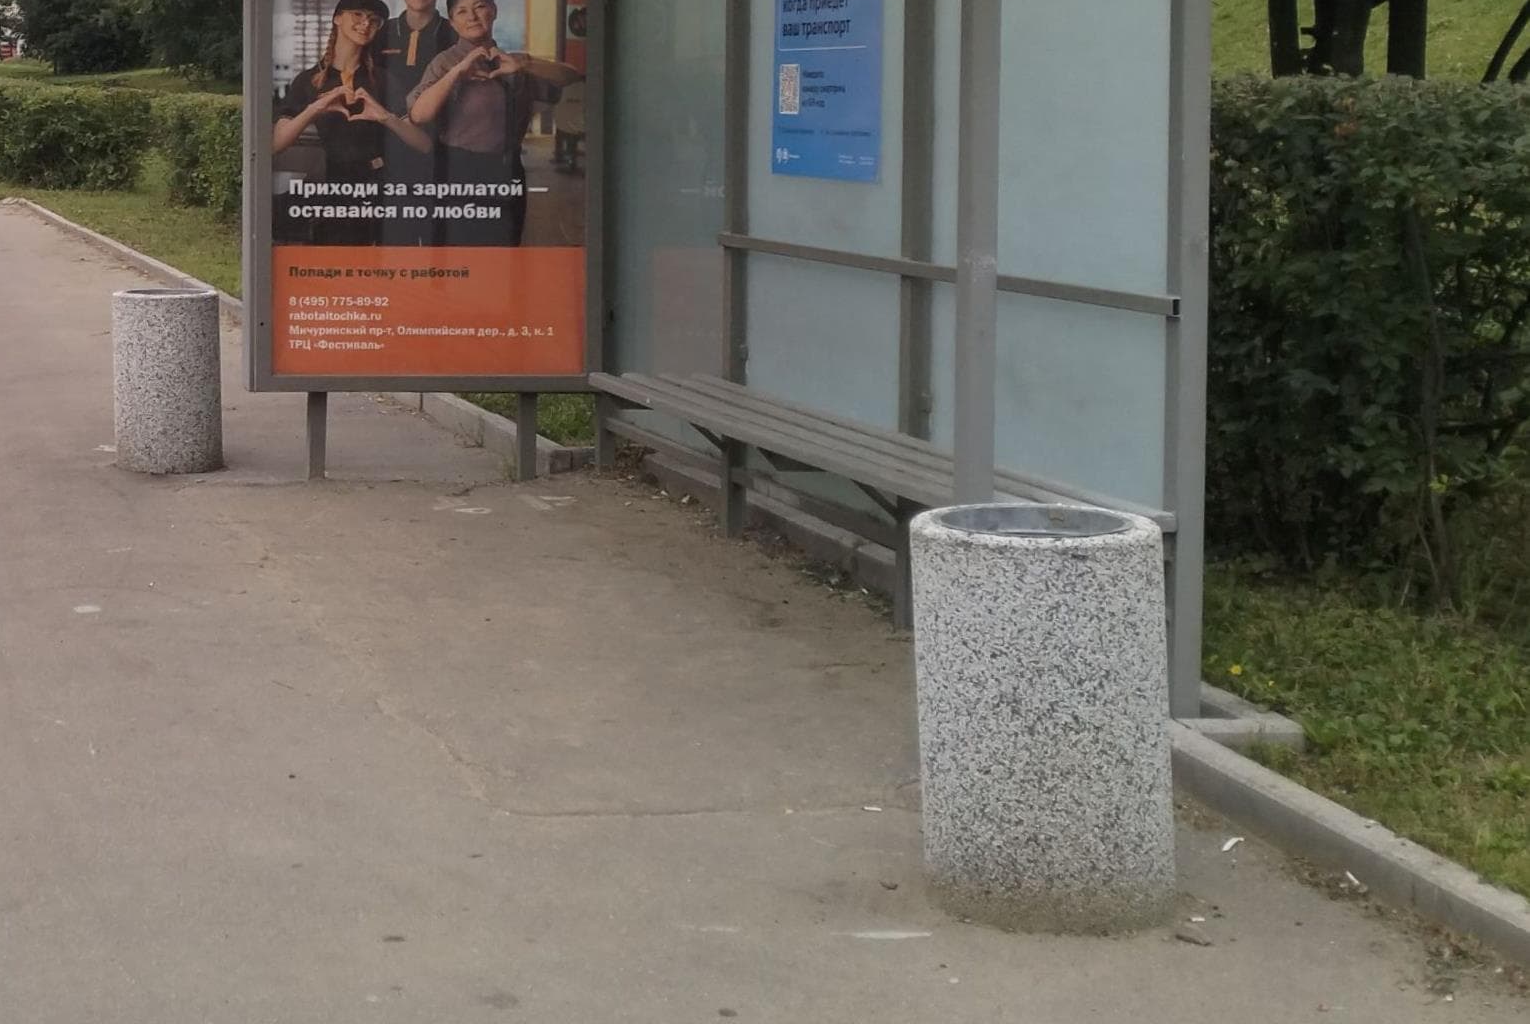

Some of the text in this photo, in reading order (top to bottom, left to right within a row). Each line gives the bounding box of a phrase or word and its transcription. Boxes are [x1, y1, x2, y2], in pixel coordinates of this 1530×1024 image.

[782, 19, 851, 39] ваш транспорт
[289, 179, 378, 198] Приходи
[383, 182, 407, 196] за
[412, 179, 523, 199] зарплатой
[289, 201, 501, 218] оставайся по любви
[289, 266, 469, 279] Попади в точку с работой
[289, 296, 389, 308] 8 (495) 775-89-92
[289, 325, 366, 336] Мичуринский
[397, 326, 475, 336] Олимпийская
[289, 339, 311, 350] ТРЦ
